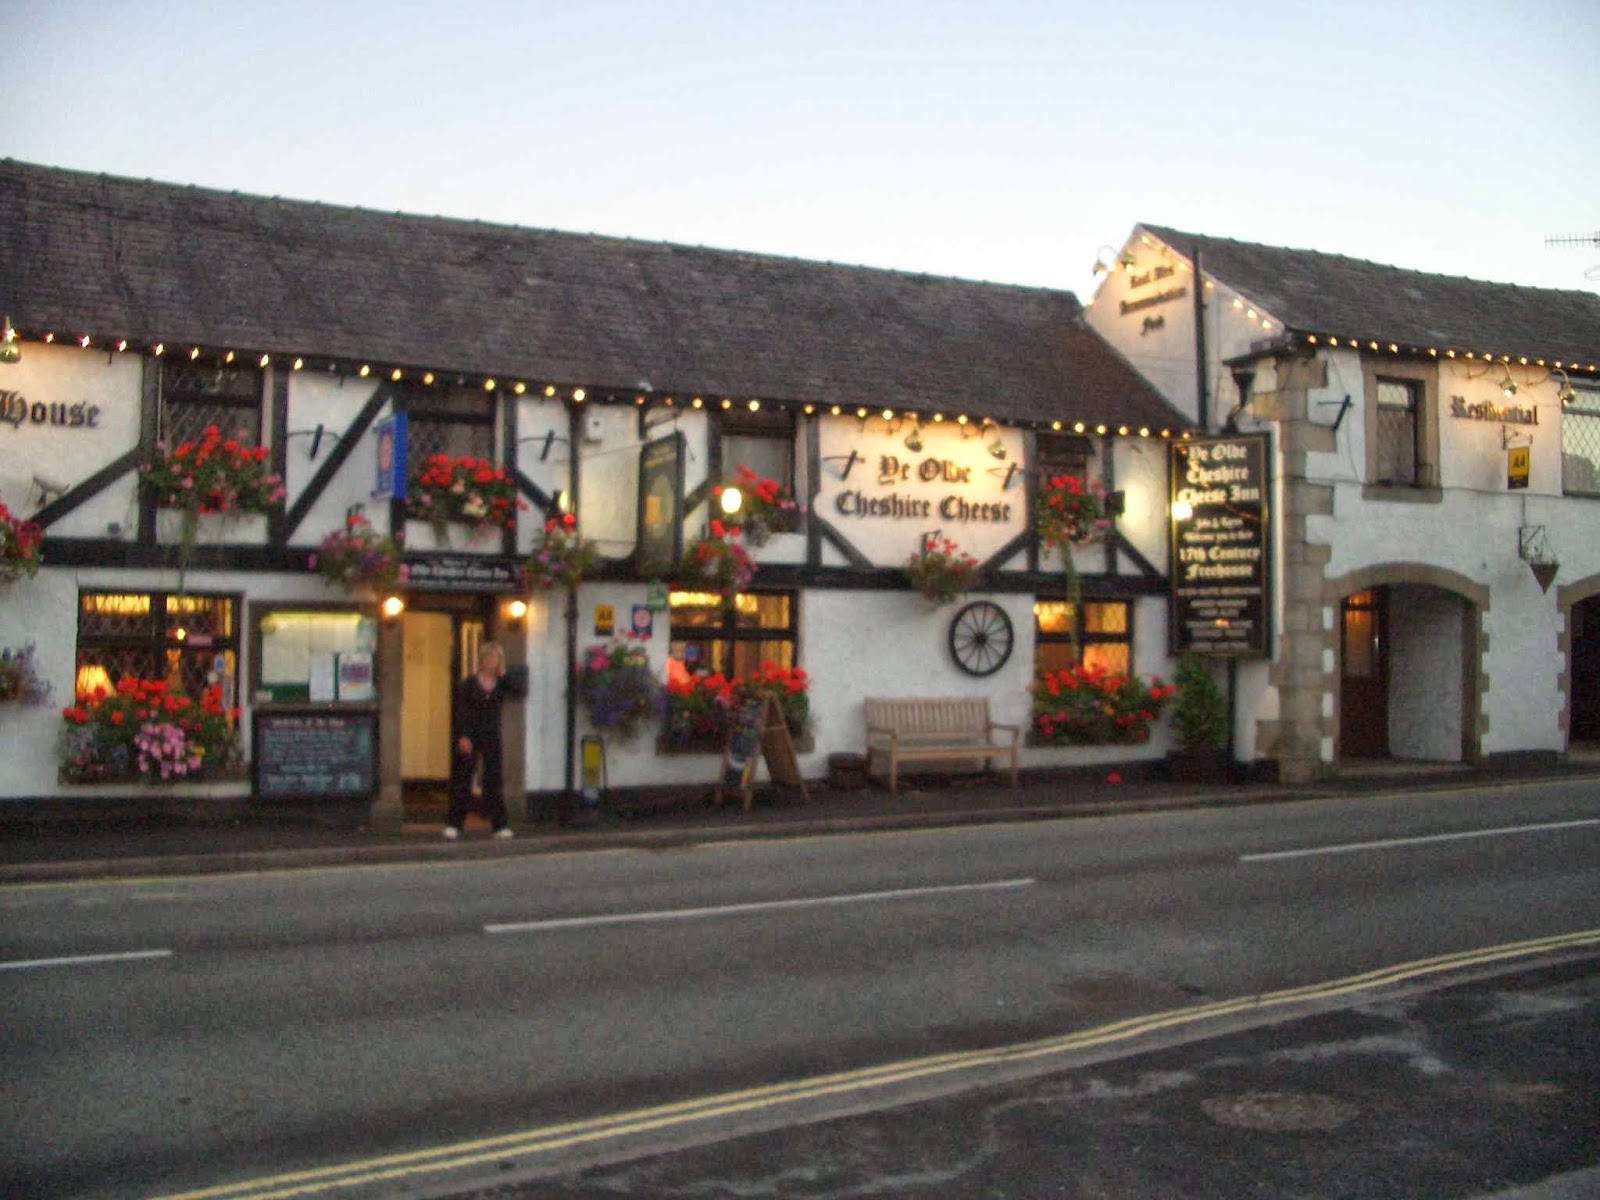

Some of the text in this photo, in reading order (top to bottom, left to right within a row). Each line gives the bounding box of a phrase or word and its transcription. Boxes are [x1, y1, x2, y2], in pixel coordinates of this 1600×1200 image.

[0, 389, 100, 430] House
[1211, 444, 1247, 460] Olde
[878, 455, 971, 485] Ye Olde
[1186, 466, 1249, 484] Cheshire
[1178, 485, 1260, 506] Cheese Inn
[835, 490, 1011, 524] Cheshire Cheese
[1179, 546, 1260, 561] 17th Century
[1185, 563, 1253, 580] Freehouse
